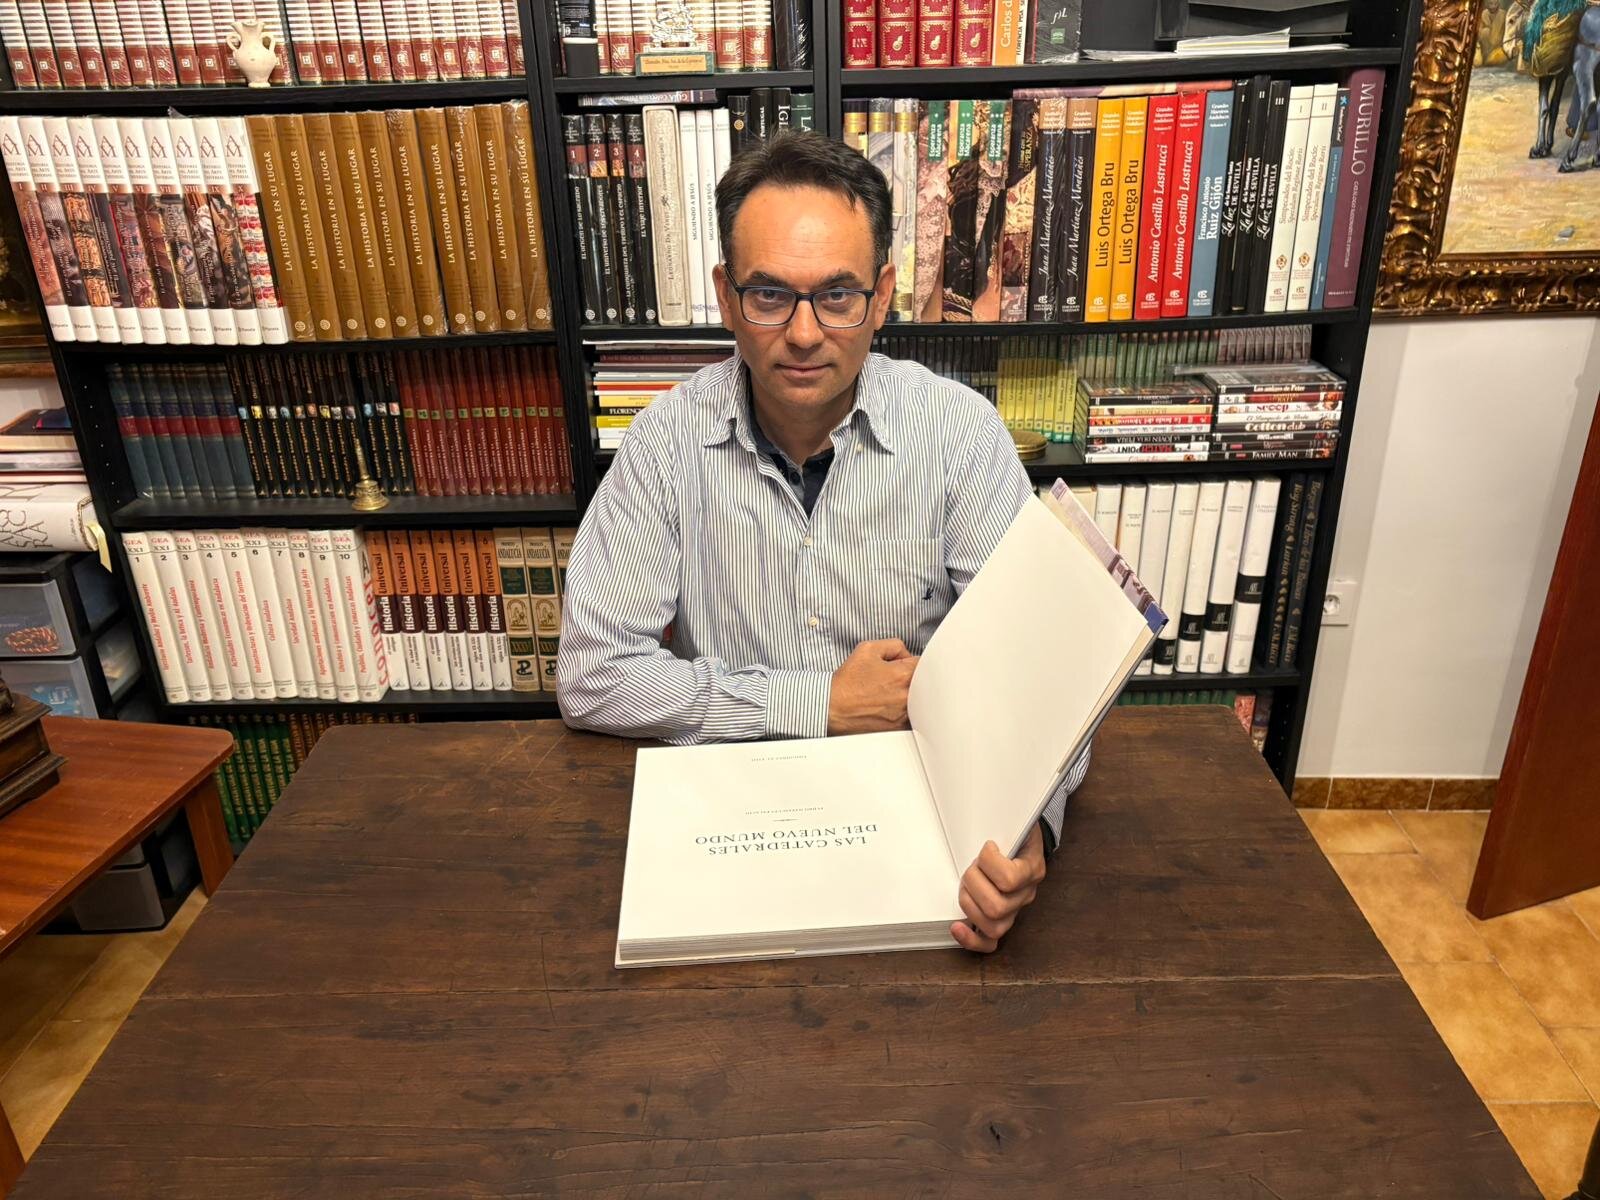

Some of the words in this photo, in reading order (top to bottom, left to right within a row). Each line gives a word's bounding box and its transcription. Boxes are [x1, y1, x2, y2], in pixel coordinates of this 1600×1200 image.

[1000, 10, 1012, 48] Carlos
[1352, 82, 1375, 176] MURILLO
[264, 152, 275, 182] LUGAR
[320, 151, 330, 180] LUGAR
[348, 149, 359, 179] LUGAR
[432, 144, 442, 174] LUGAR
[487, 140, 496, 170] LUGAR
[1154, 145, 1167, 194] Lastrucci
[1180, 142, 1193, 190] Lastrucci
[437, 178, 444, 189] SU
[491, 174, 498, 185] SU
[1101, 163, 1114, 186] Bru
[1125, 160, 1139, 183] Bru
[1232, 161, 1242, 194] SEVILLA
[271, 186, 278, 196] SU
[326, 185, 333, 195] SU
[354, 183, 362, 194] SU
[357, 198, 364, 209] EN
[439, 193, 446, 204] EN
[492, 189, 500, 200] EN
[1201, 176, 1212, 206] Antonio
[1208, 175, 1225, 210] Gijón
[1232, 195, 1239, 206] DE
[274, 200, 281, 212] EN
[328, 199, 336, 210] EN
[1098, 192, 1114, 237] Ortega
[1121, 189, 1138, 234] Ortega
[1151, 198, 1163, 238] Castillo
[1176, 194, 1188, 234] Castillo
[277, 215, 290, 257] HISTORIA
[331, 214, 343, 256] HISTORIA
[360, 212, 372, 254] HISTORIA
[442, 208, 453, 250] HISTORIA
[495, 204, 505, 246] HISTORIA
[1068, 203, 1083, 253] Martínez
[1198, 206, 1209, 240] Francisco
[1205, 211, 1220, 240] Ruiz
[286, 261, 293, 271] LA
[339, 259, 346, 269] LA
[368, 258, 375, 268] LA
[449, 253, 455, 263] LA
[500, 249, 507, 259] LA
[1096, 242, 1109, 267] Luis
[1119, 239, 1133, 264] Luis
[1148, 241, 1160, 282] Antonio
[1173, 237, 1185, 279] Antonio
[1066, 256, 1080, 280] Juan
[1245, 422, 1286, 431] Cotton
[372, 553, 387, 594] Universal
[395, 553, 408, 593] Universal
[417, 553, 431, 593] Universal
[438, 553, 452, 593] Universal
[460, 553, 473, 593] Universal
[482, 553, 495, 593] Universal
[380, 597, 393, 631] Historia
[402, 596, 415, 630] Historia
[424, 596, 437, 630] Historia
[445, 596, 458, 630] Historia
[467, 596, 479, 630] Historia
[488, 596, 500, 630] Historia
[695, 832, 765, 845] MUNDO
[773, 827, 835, 838] NUEVO
[835, 836, 866, 846] LAS
[843, 824, 877, 834] DEL
[709, 840, 827, 855] CATEDRALES
